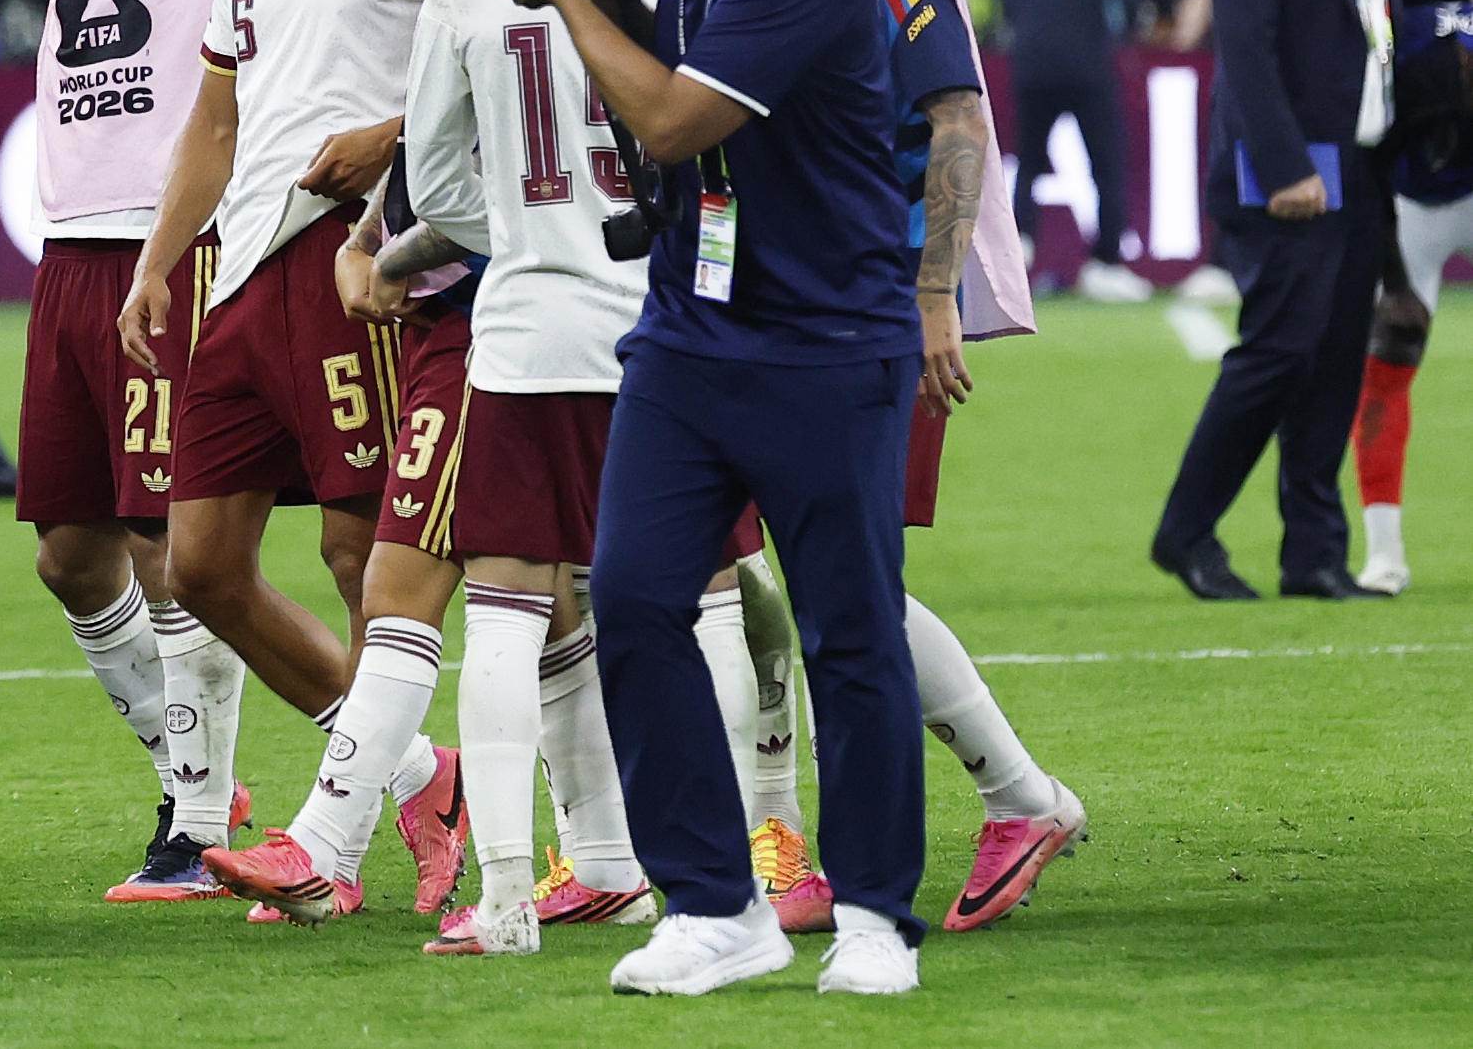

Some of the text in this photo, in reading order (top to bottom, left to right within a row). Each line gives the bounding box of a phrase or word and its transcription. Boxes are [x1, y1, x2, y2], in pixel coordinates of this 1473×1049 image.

[76, 23, 121, 50] FIFA
[58, 87, 154, 125] 2026
[59, 66, 153, 94] WORLD CUP
[124, 378, 171, 454] 21
[322, 353, 370, 432] 5
[396, 408, 446, 480] 3
